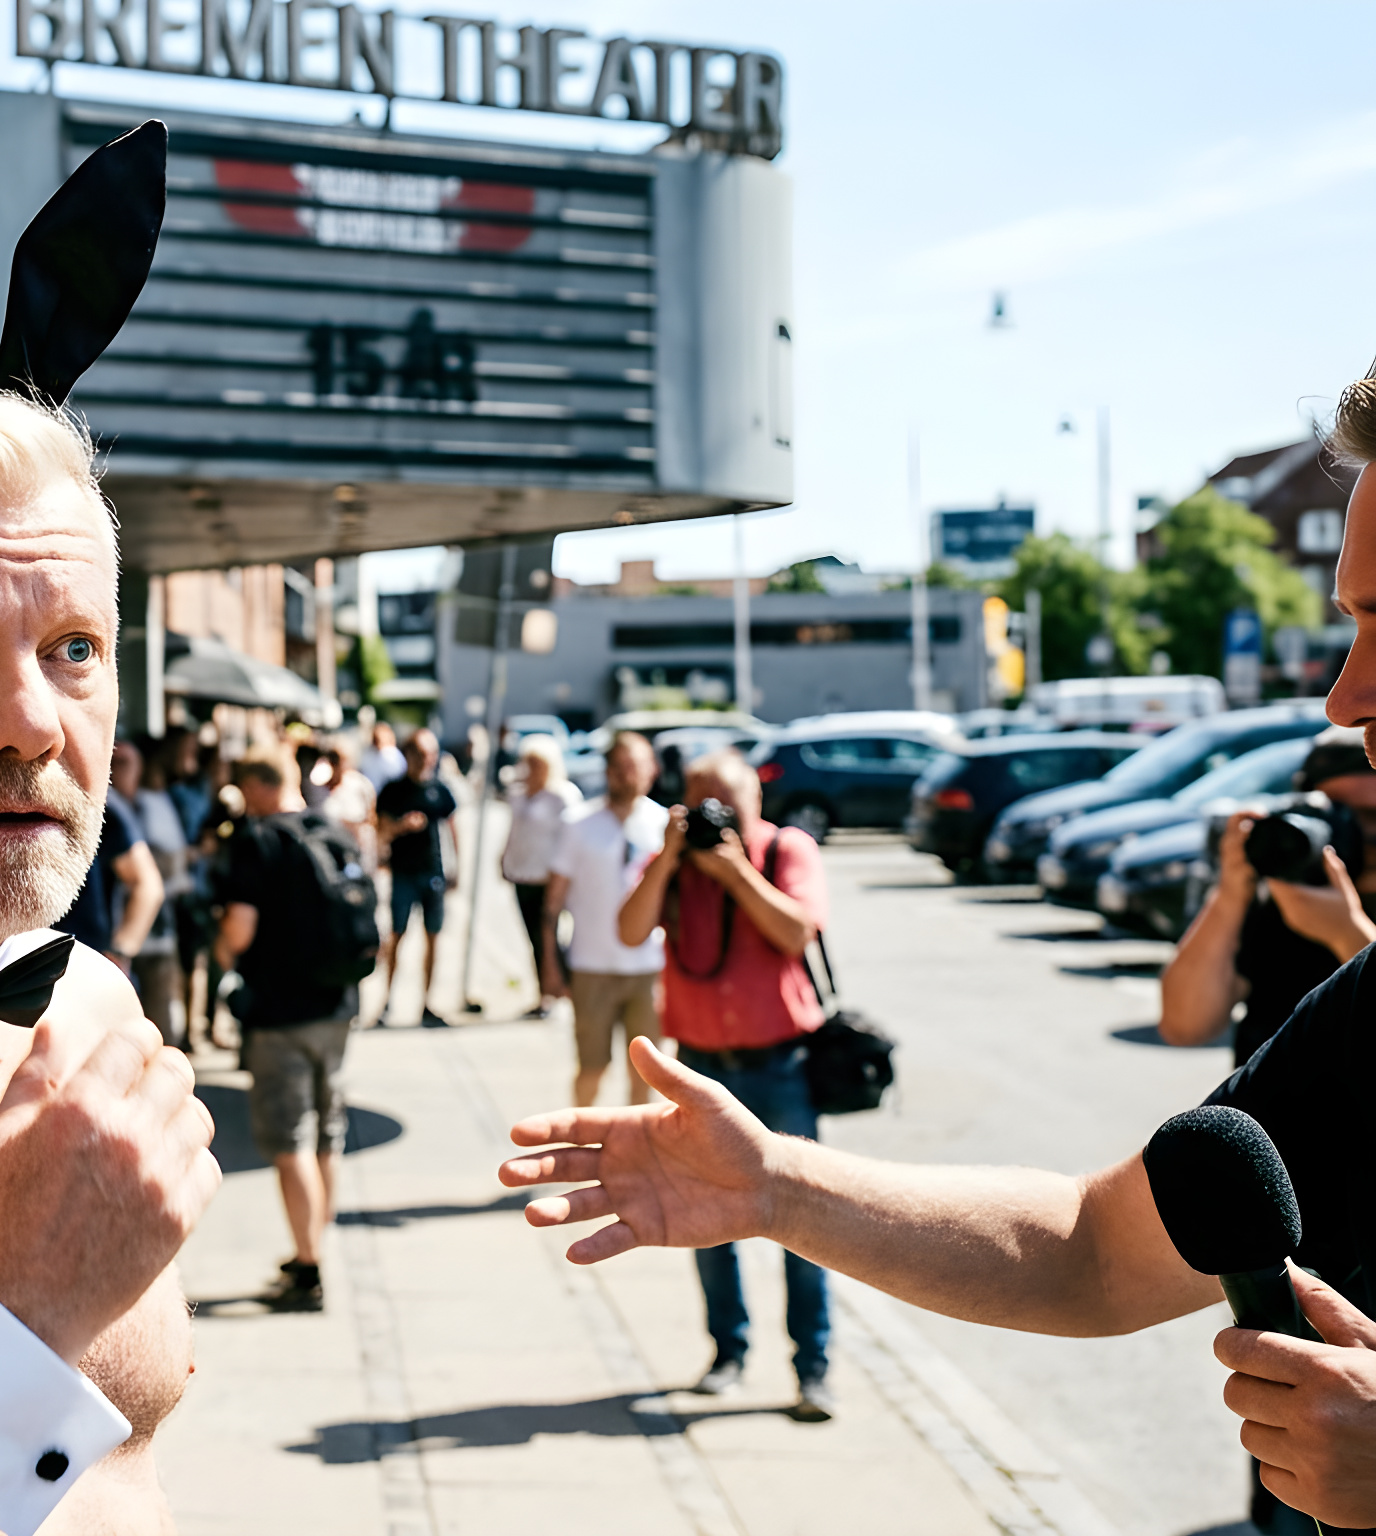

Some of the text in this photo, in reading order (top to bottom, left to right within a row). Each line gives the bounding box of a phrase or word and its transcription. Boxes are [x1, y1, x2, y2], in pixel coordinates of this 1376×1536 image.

[17, 0, 784, 143] BREMEN THEATER
[307, 323, 385, 396] 15
